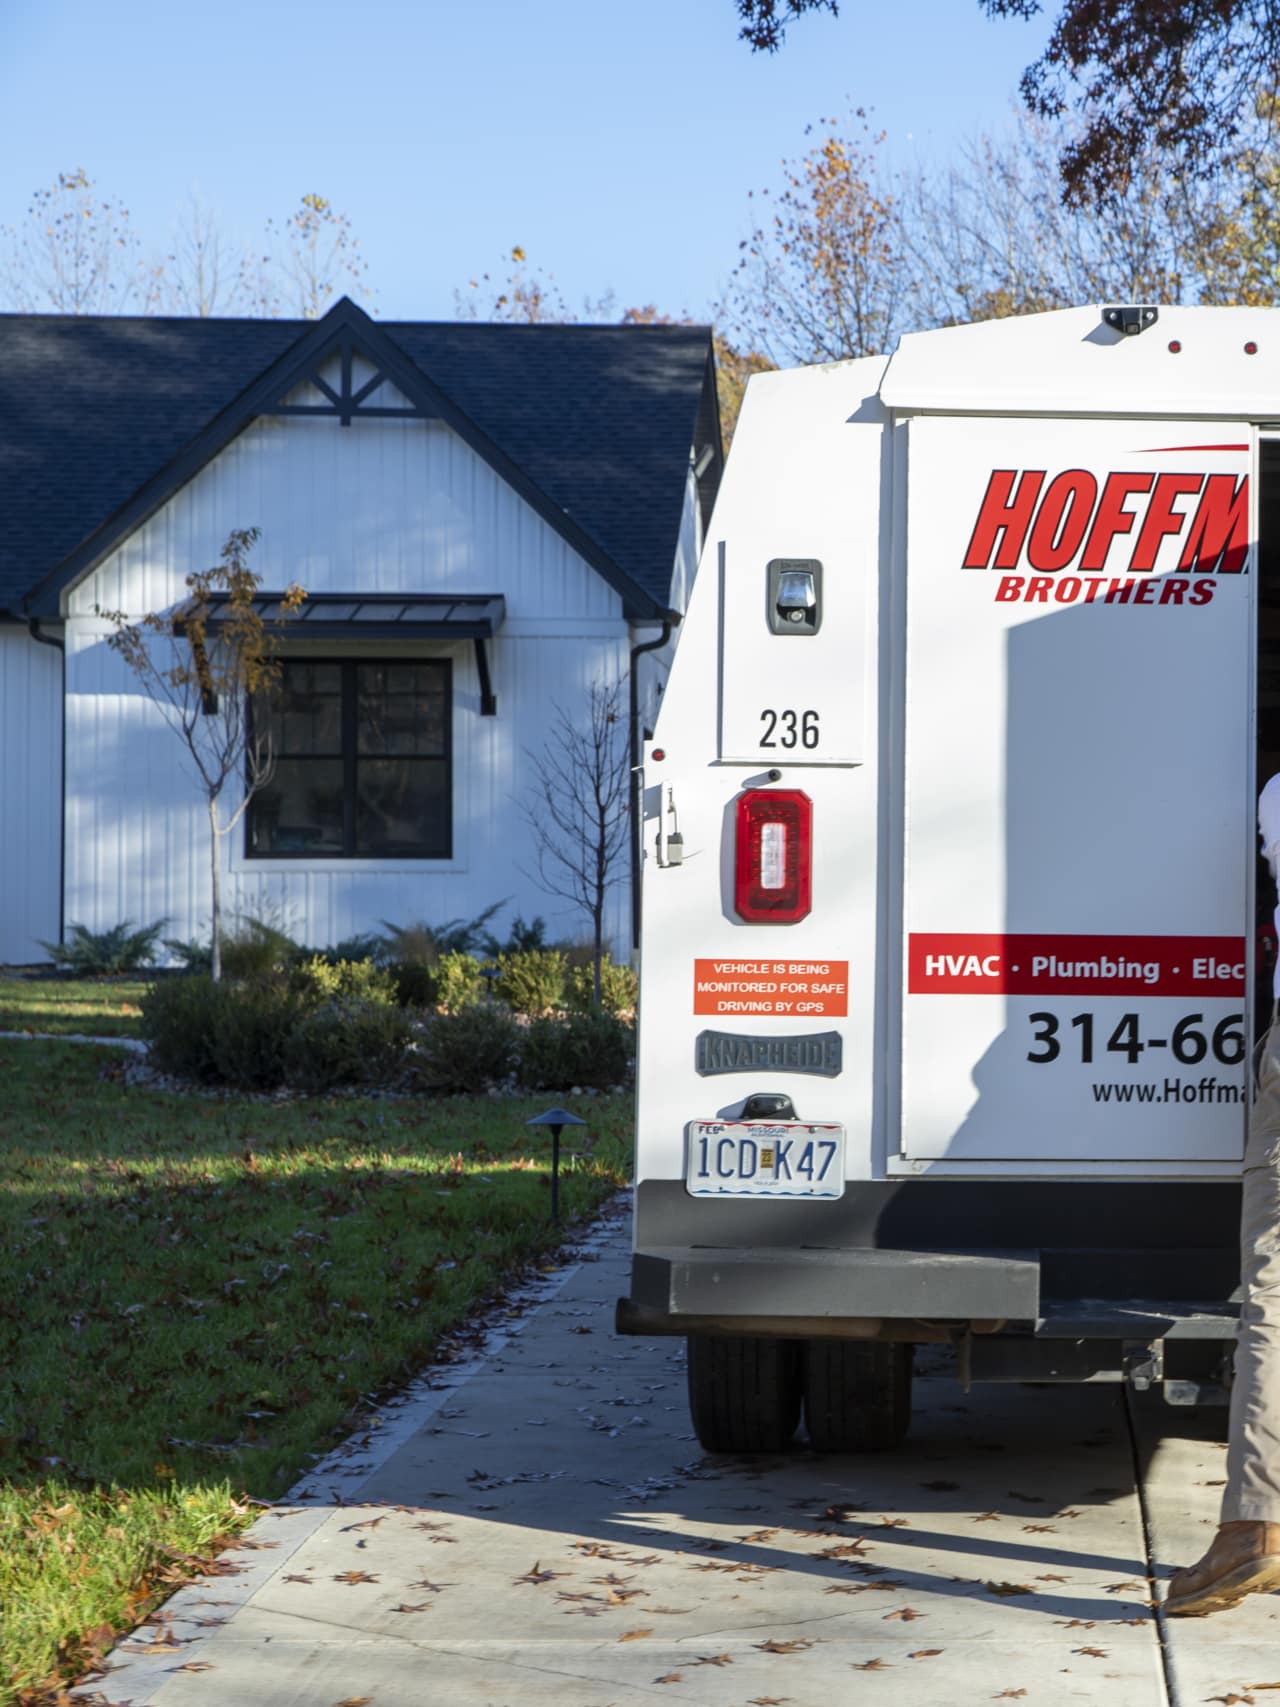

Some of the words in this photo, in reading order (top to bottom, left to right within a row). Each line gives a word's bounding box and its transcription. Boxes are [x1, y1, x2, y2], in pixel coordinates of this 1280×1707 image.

[961, 469, 1248, 574] HOFFM
[994, 576, 1217, 606] BROTHERS
[759, 709, 820, 749] 236
[713, 963, 770, 974] VEHICLE
[773, 964, 786, 974] IS
[788, 964, 830, 975] BEING
[925, 955, 1000, 977] HVAC
[1032, 955, 1160, 984] Plumbing
[1192, 957, 1246, 979] Elec
[697, 982, 777, 993] MONITORED
[780, 983, 808, 993] FOR
[811, 983, 845, 994] SAFE
[717, 1001, 772, 1011] DRIVING
[775, 1002, 793, 1011] BY
[796, 1002, 825, 1012] GPS
[704, 1037, 832, 1068] KNAPHEIDE
[1026, 1012, 1246, 1065] 314-66
[698, 1137, 758, 1179] 1CD
[774, 1140, 838, 1181] K47
